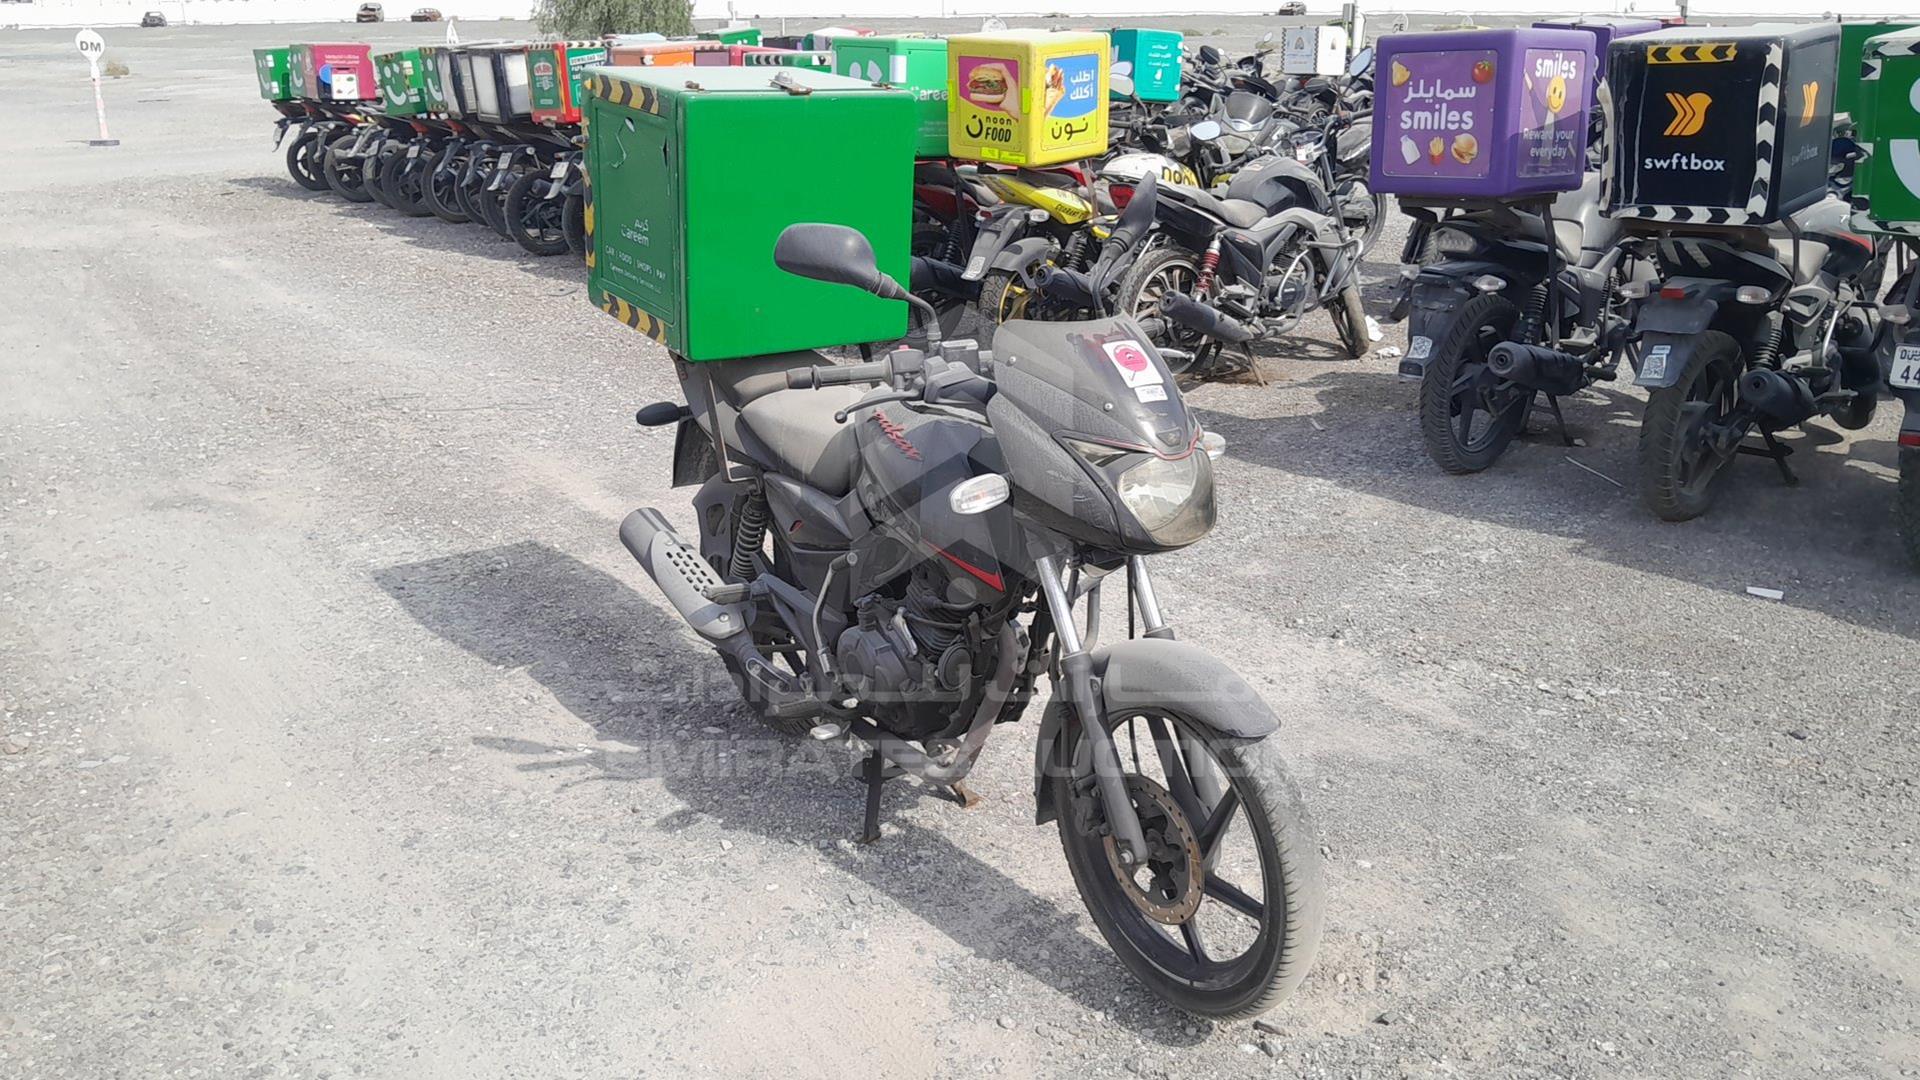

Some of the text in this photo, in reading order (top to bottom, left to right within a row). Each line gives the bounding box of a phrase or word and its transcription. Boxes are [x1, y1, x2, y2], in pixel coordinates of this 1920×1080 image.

[80, 40, 101, 52] DM
[1535, 52, 1577, 80] smiles
[1070, 69, 1095, 83] اطلب
[1403, 78, 1476, 103] سمايلز
[986, 116, 1012, 125] noon
[1400, 102, 1474, 130] smiles
[985, 127, 1012, 142] FOOD
[1052, 117, 1088, 141] نون
[1523, 127, 1574, 143] Reward your
[1530, 144, 1567, 160] everyday
[1644, 152, 1725, 171] swftbox
[620, 223, 649, 247] Careem
